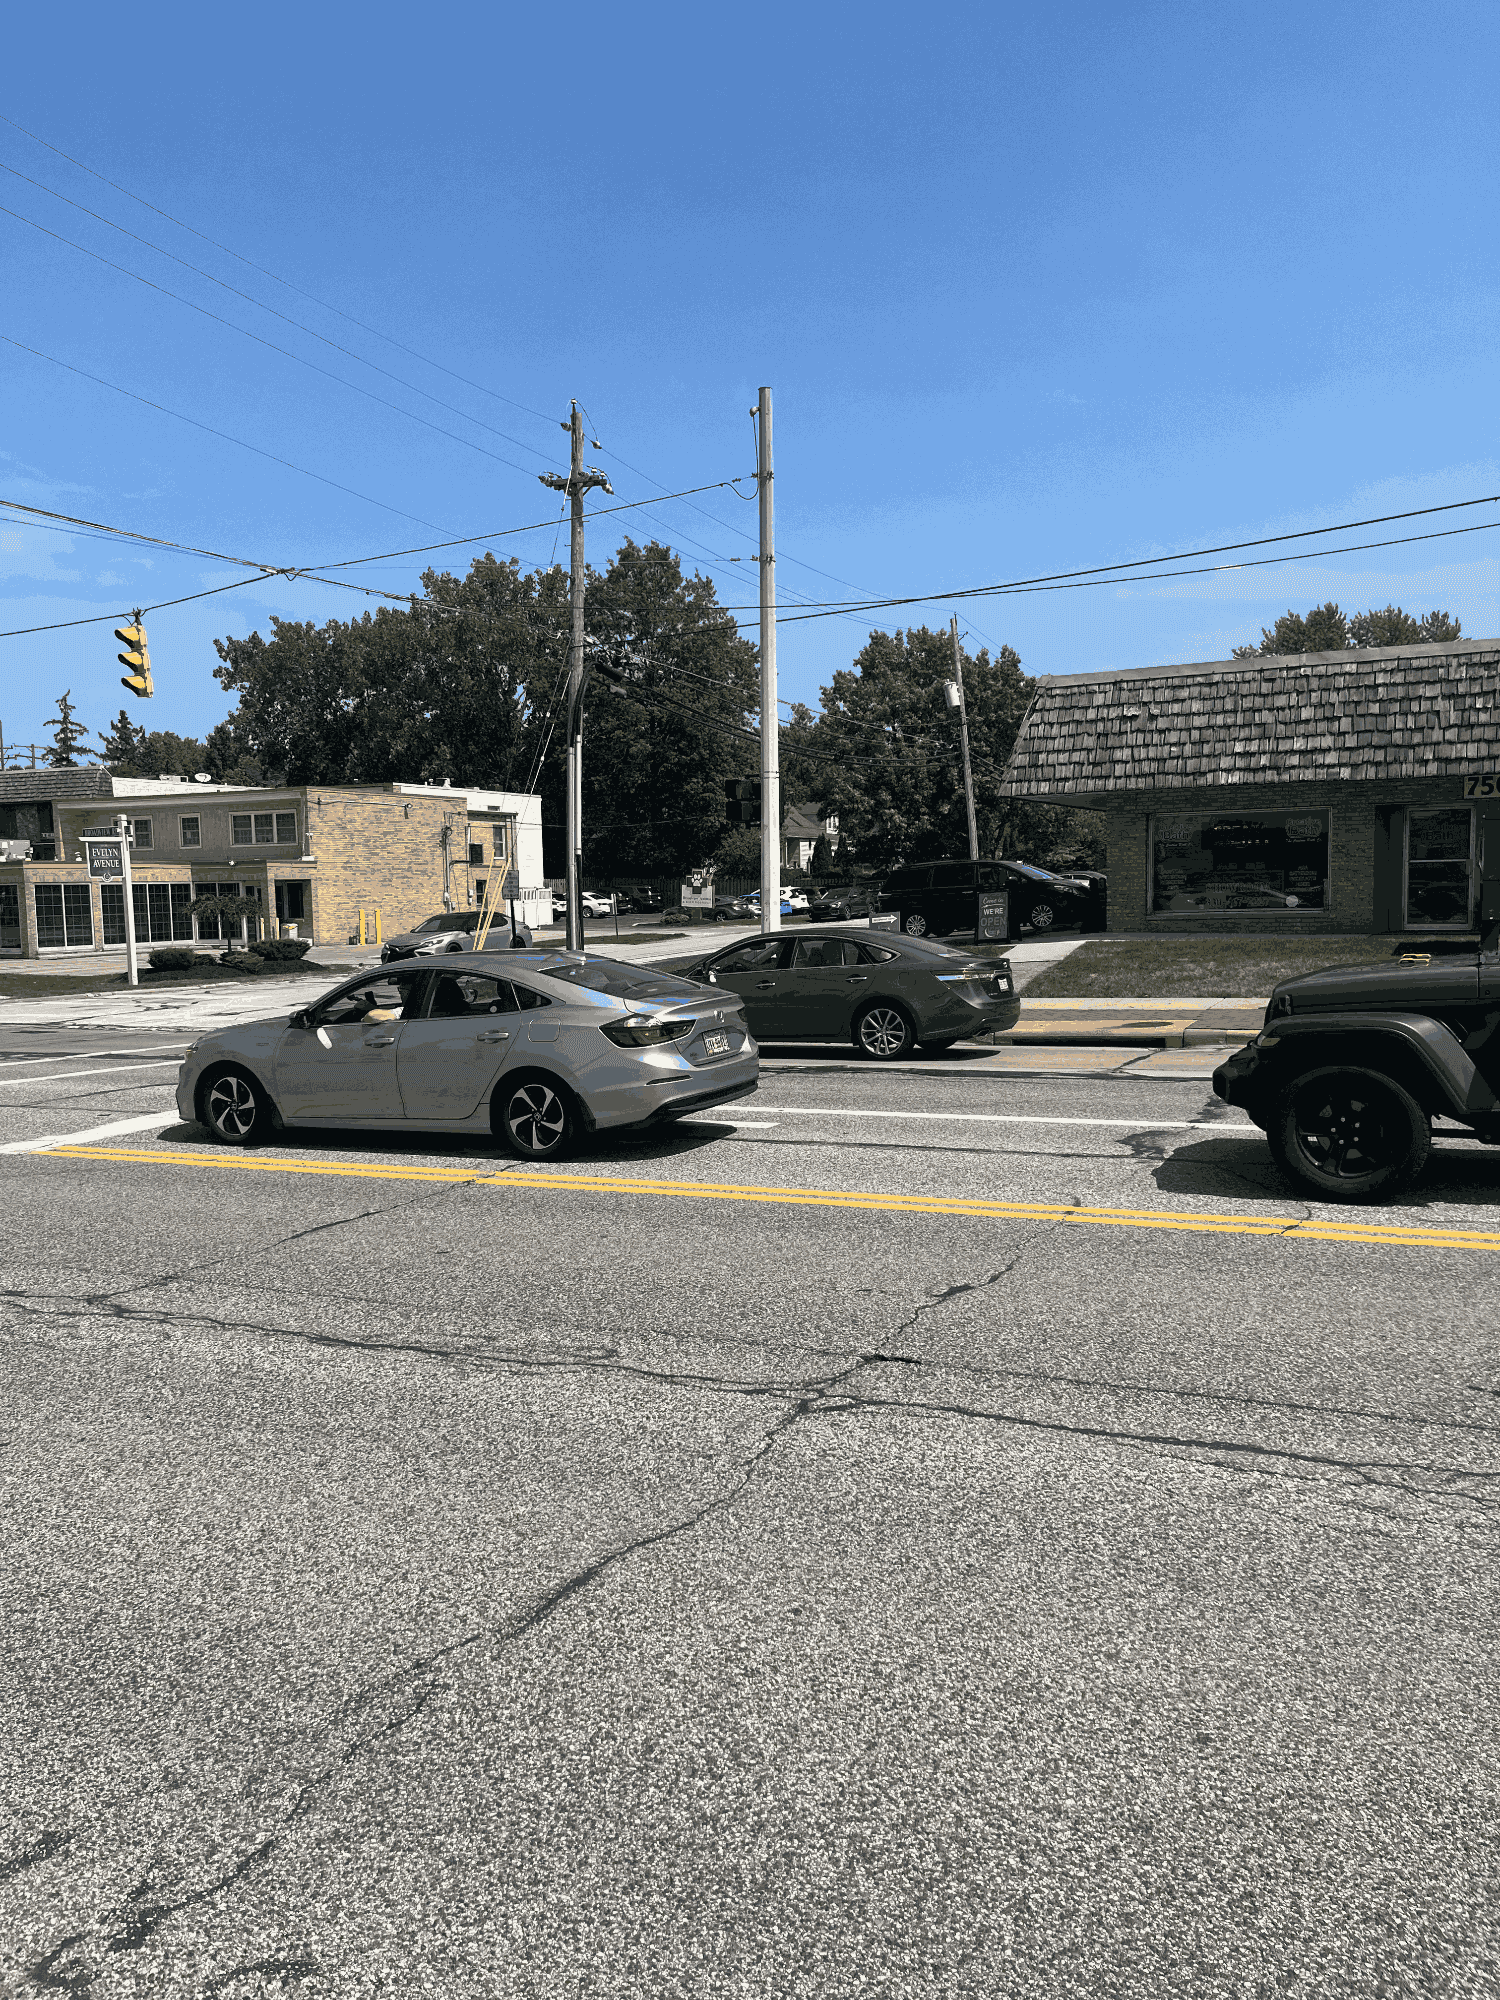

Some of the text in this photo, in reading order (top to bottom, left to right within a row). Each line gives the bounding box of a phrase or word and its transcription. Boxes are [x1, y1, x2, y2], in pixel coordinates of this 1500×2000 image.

[92, 848, 119, 857] EVELYN
[93, 859, 120, 868] AVENUE
[980, 916, 1007, 927] OPEN
